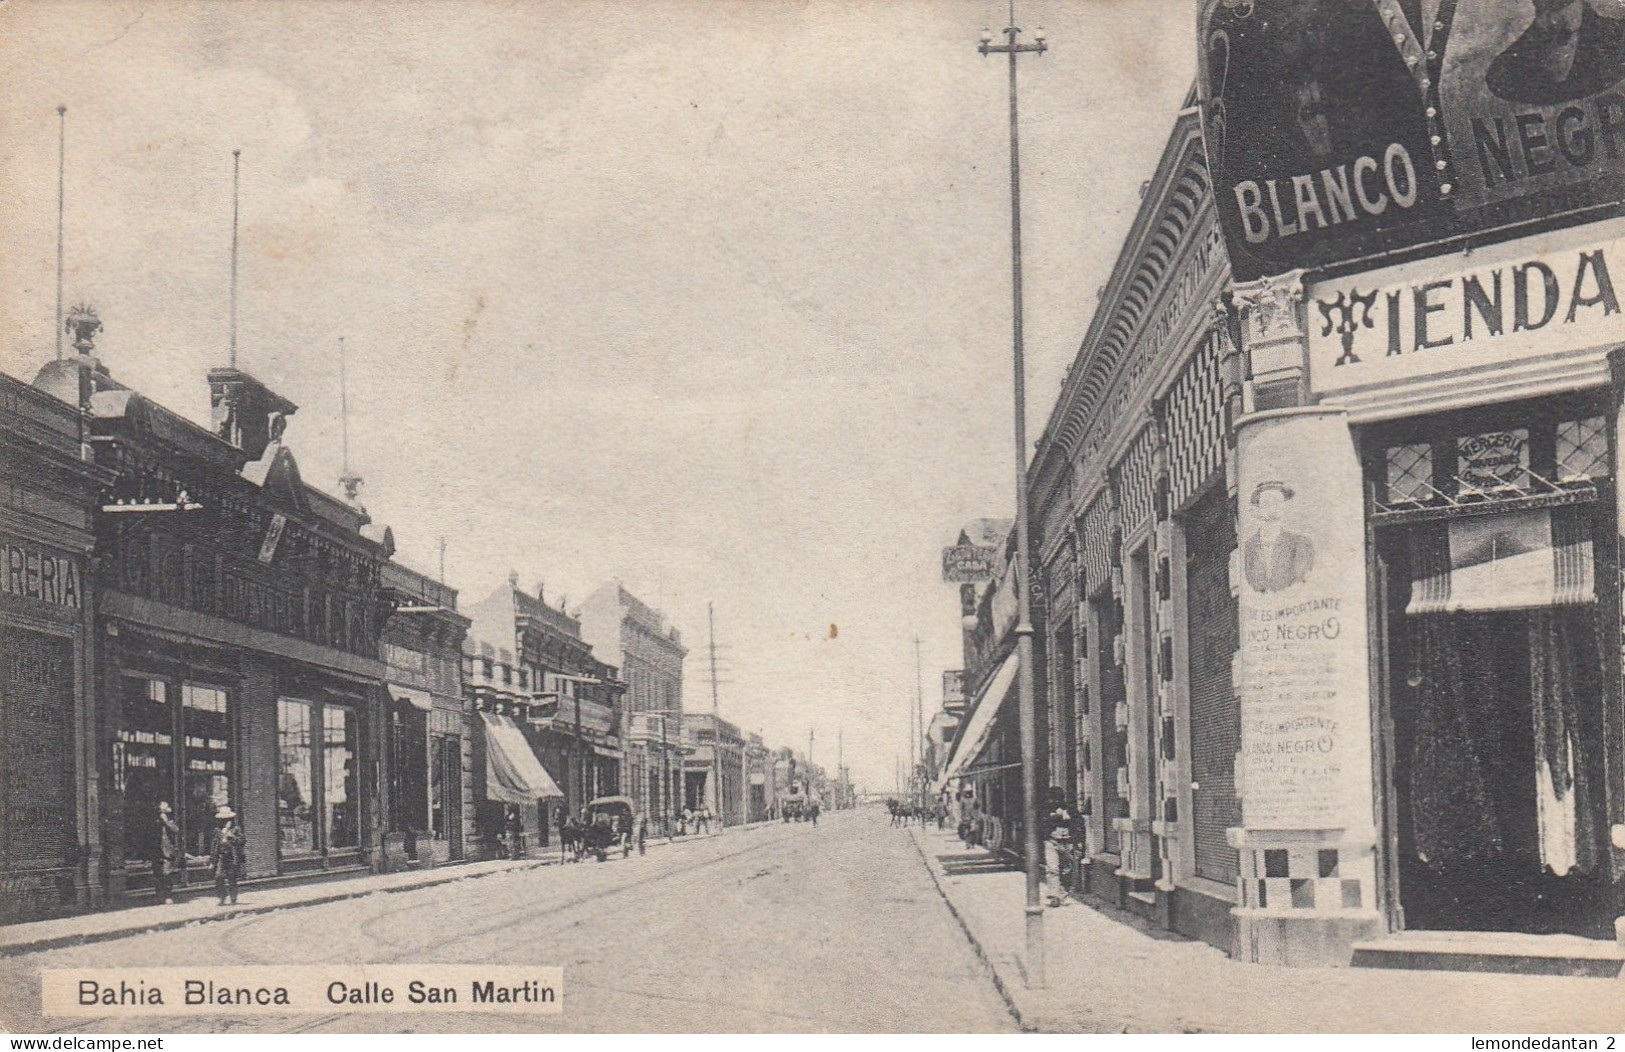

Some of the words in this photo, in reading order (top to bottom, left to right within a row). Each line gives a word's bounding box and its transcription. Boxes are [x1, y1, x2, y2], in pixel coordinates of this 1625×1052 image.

[1234, 143, 1417, 243] BLANCO
[1316, 248, 1622, 367] TIENDA
[0, 541, 81, 608] RERIA
[1275, 598, 1341, 620] IMPORTANTE
[1276, 616, 1341, 641] NEGRO
[1275, 716, 1340, 734] IMPORTANTE
[1277, 735, 1334, 754] NEGRO
